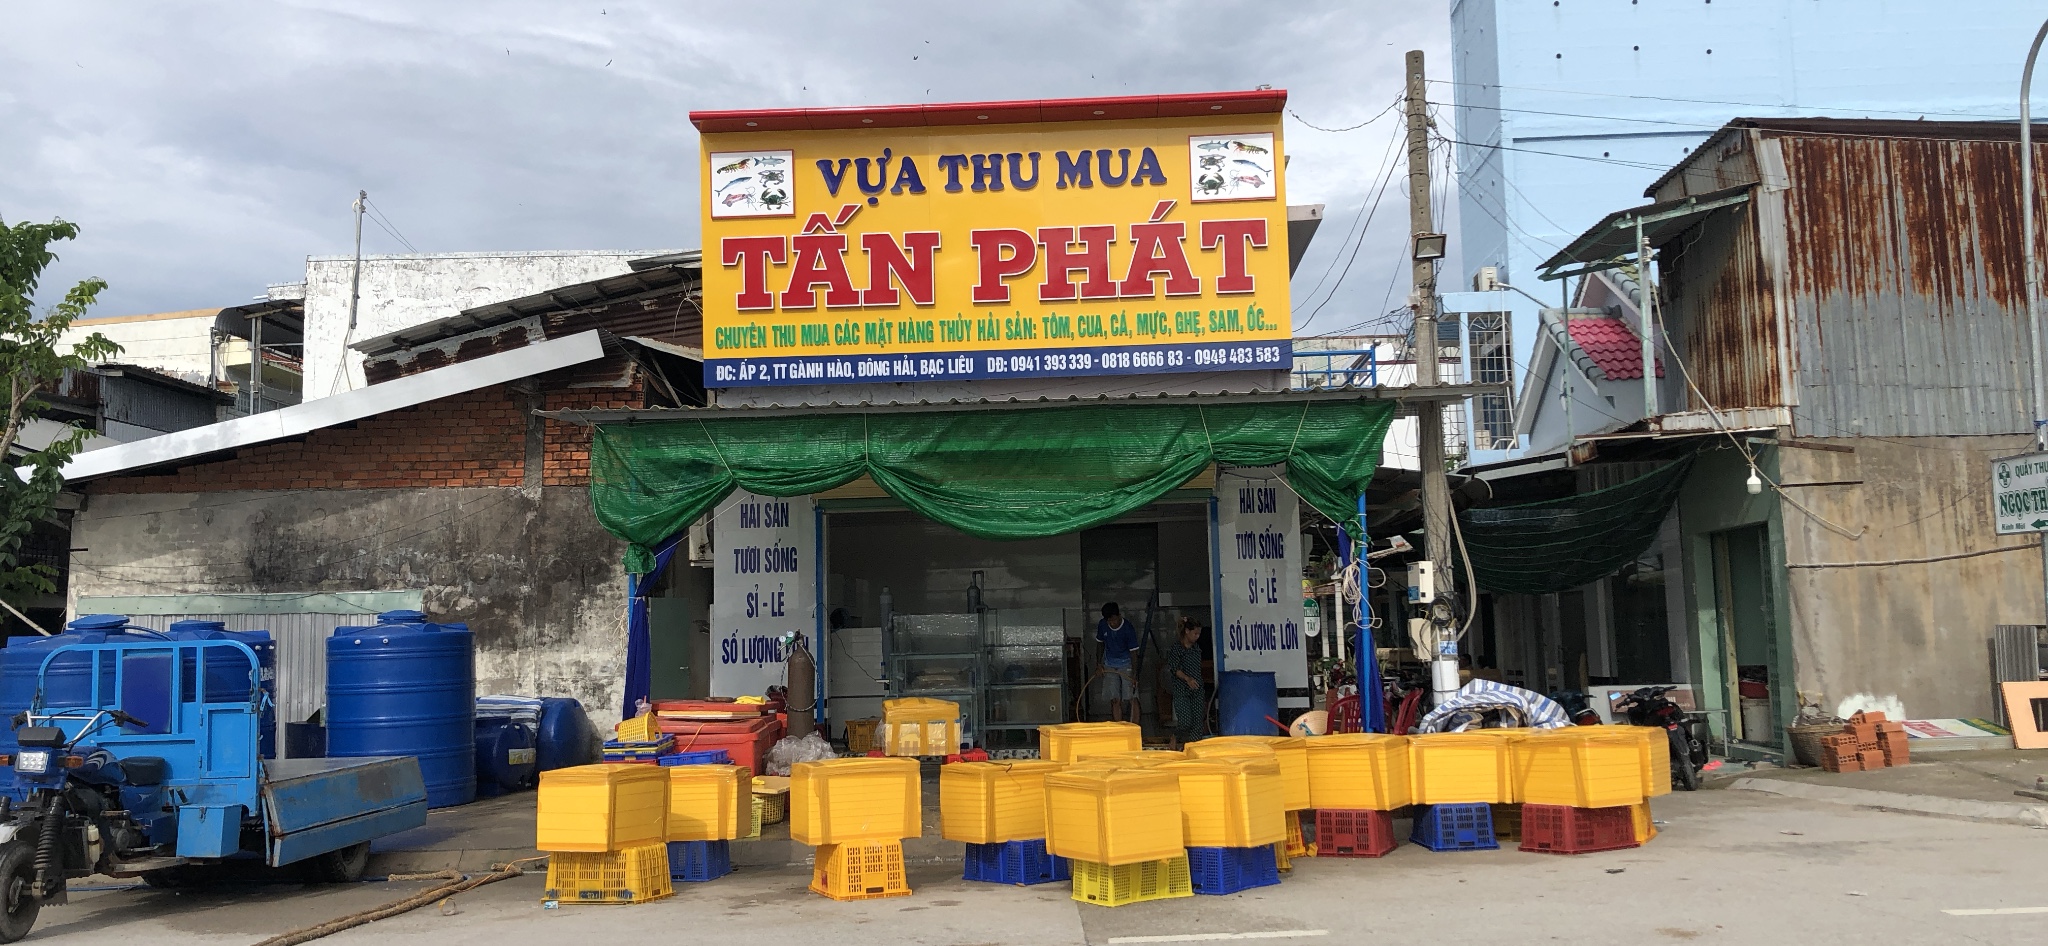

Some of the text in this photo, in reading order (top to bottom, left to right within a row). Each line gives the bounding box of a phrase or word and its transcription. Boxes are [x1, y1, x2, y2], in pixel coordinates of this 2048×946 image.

[815, 146, 1167, 205] VỰA THU MUA
[720, 199, 1268, 311] TẤN PHÁT
[715, 301, 1278, 350] CHUYÊN THU MUA CÁC MẶT HÀNG THỦY HẢI SẢN: TÔM, CUA, CÁ, MỰC, GHẸ, SAM, ỐC...
[716, 364, 737, 381] ĐC:
[739, 358, 757, 381] ẤP
[759, 364, 771, 382] 2,
[772, 363, 787, 380] TT
[789, 359, 824, 380] GÀNH
[826, 358, 855, 380] HÀO,
[858, 357, 891, 378] ĐÔNG
[893, 354, 917, 378] HẢI,
[920, 358, 945, 378] BẠC
[948, 354, 974, 375] LIÊU
[987, 356, 1008, 373] DĐ:
[1010, 355, 1040, 372] 0941
[1043, 354, 1067, 371] 393
[1068, 353, 1092, 370] 339
[1101, 351, 1130, 369] 0818
[1132, 351, 1164, 368] 6666
[1167, 350, 1184, 367] 83
[1194, 348, 1227, 366] 0948
[1229, 347, 1253, 365] 483
[1255, 346, 1280, 363] 583
[740, 495, 760, 529] HẢI
[1238, 479, 1276, 514] HẢI SẢN
[1999, 491, 2030, 518] NGỌC
[734, 538, 798, 574] TƯƠI SỐNG
[1235, 524, 1284, 560] TƯƠI SỐNG
[746, 583, 759, 619] SỈ
[771, 582, 785, 617] LẺ
[1248, 568, 1259, 604] SỈ
[1266, 568, 1278, 603] LẺ
[721, 629, 738, 664] SỐ
[741, 635, 782, 669] LƯỢNG
[1229, 616, 1299, 655] SỐ LƯỢNG LỚN
